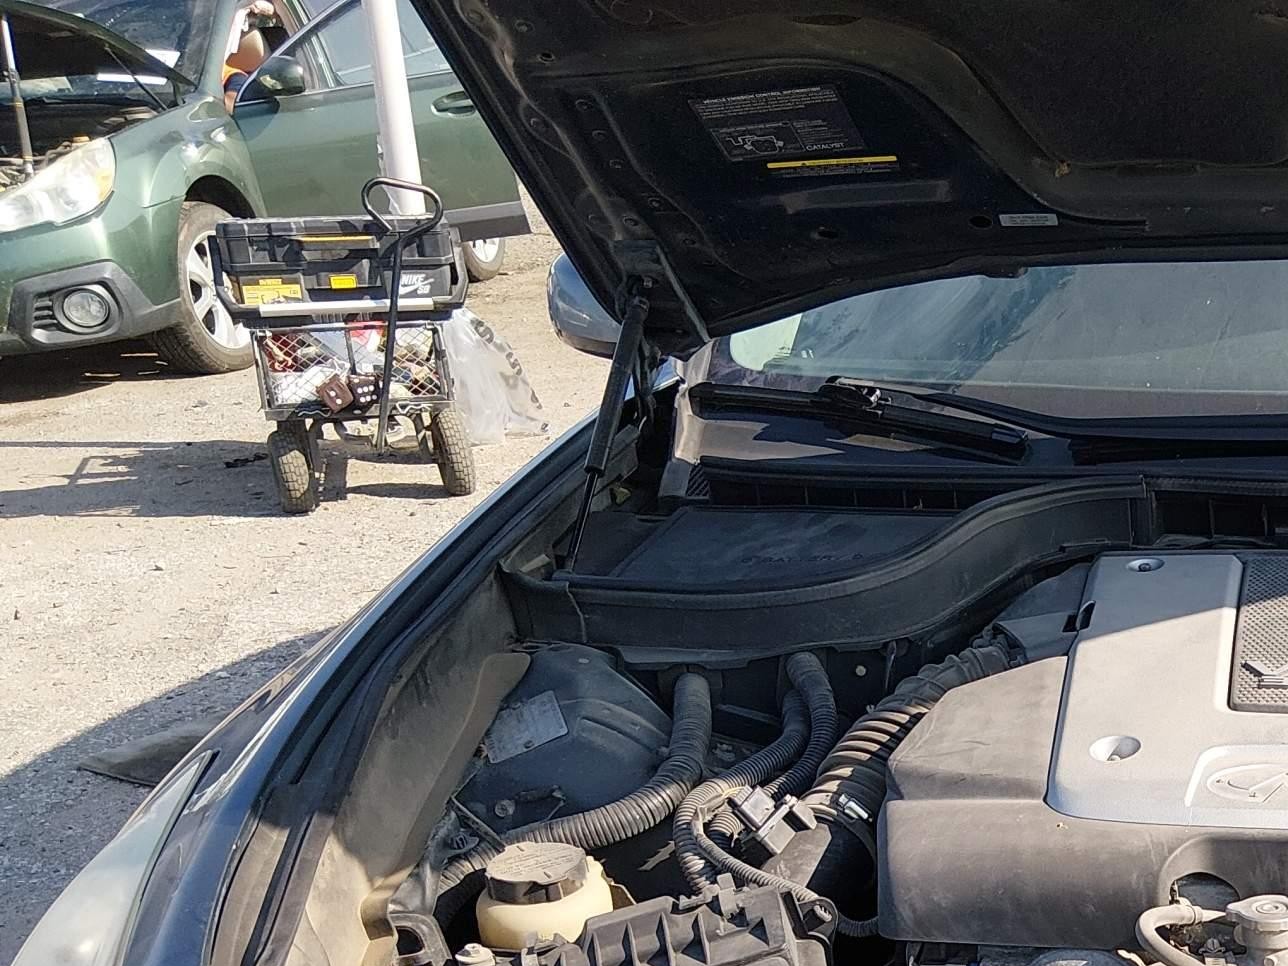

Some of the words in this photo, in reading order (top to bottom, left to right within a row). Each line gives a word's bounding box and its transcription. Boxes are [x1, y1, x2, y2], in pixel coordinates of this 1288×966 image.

[805, 141, 845, 152] CATALYST
[401, 274, 426, 285] NIKE
[417, 284, 431, 294] SB
